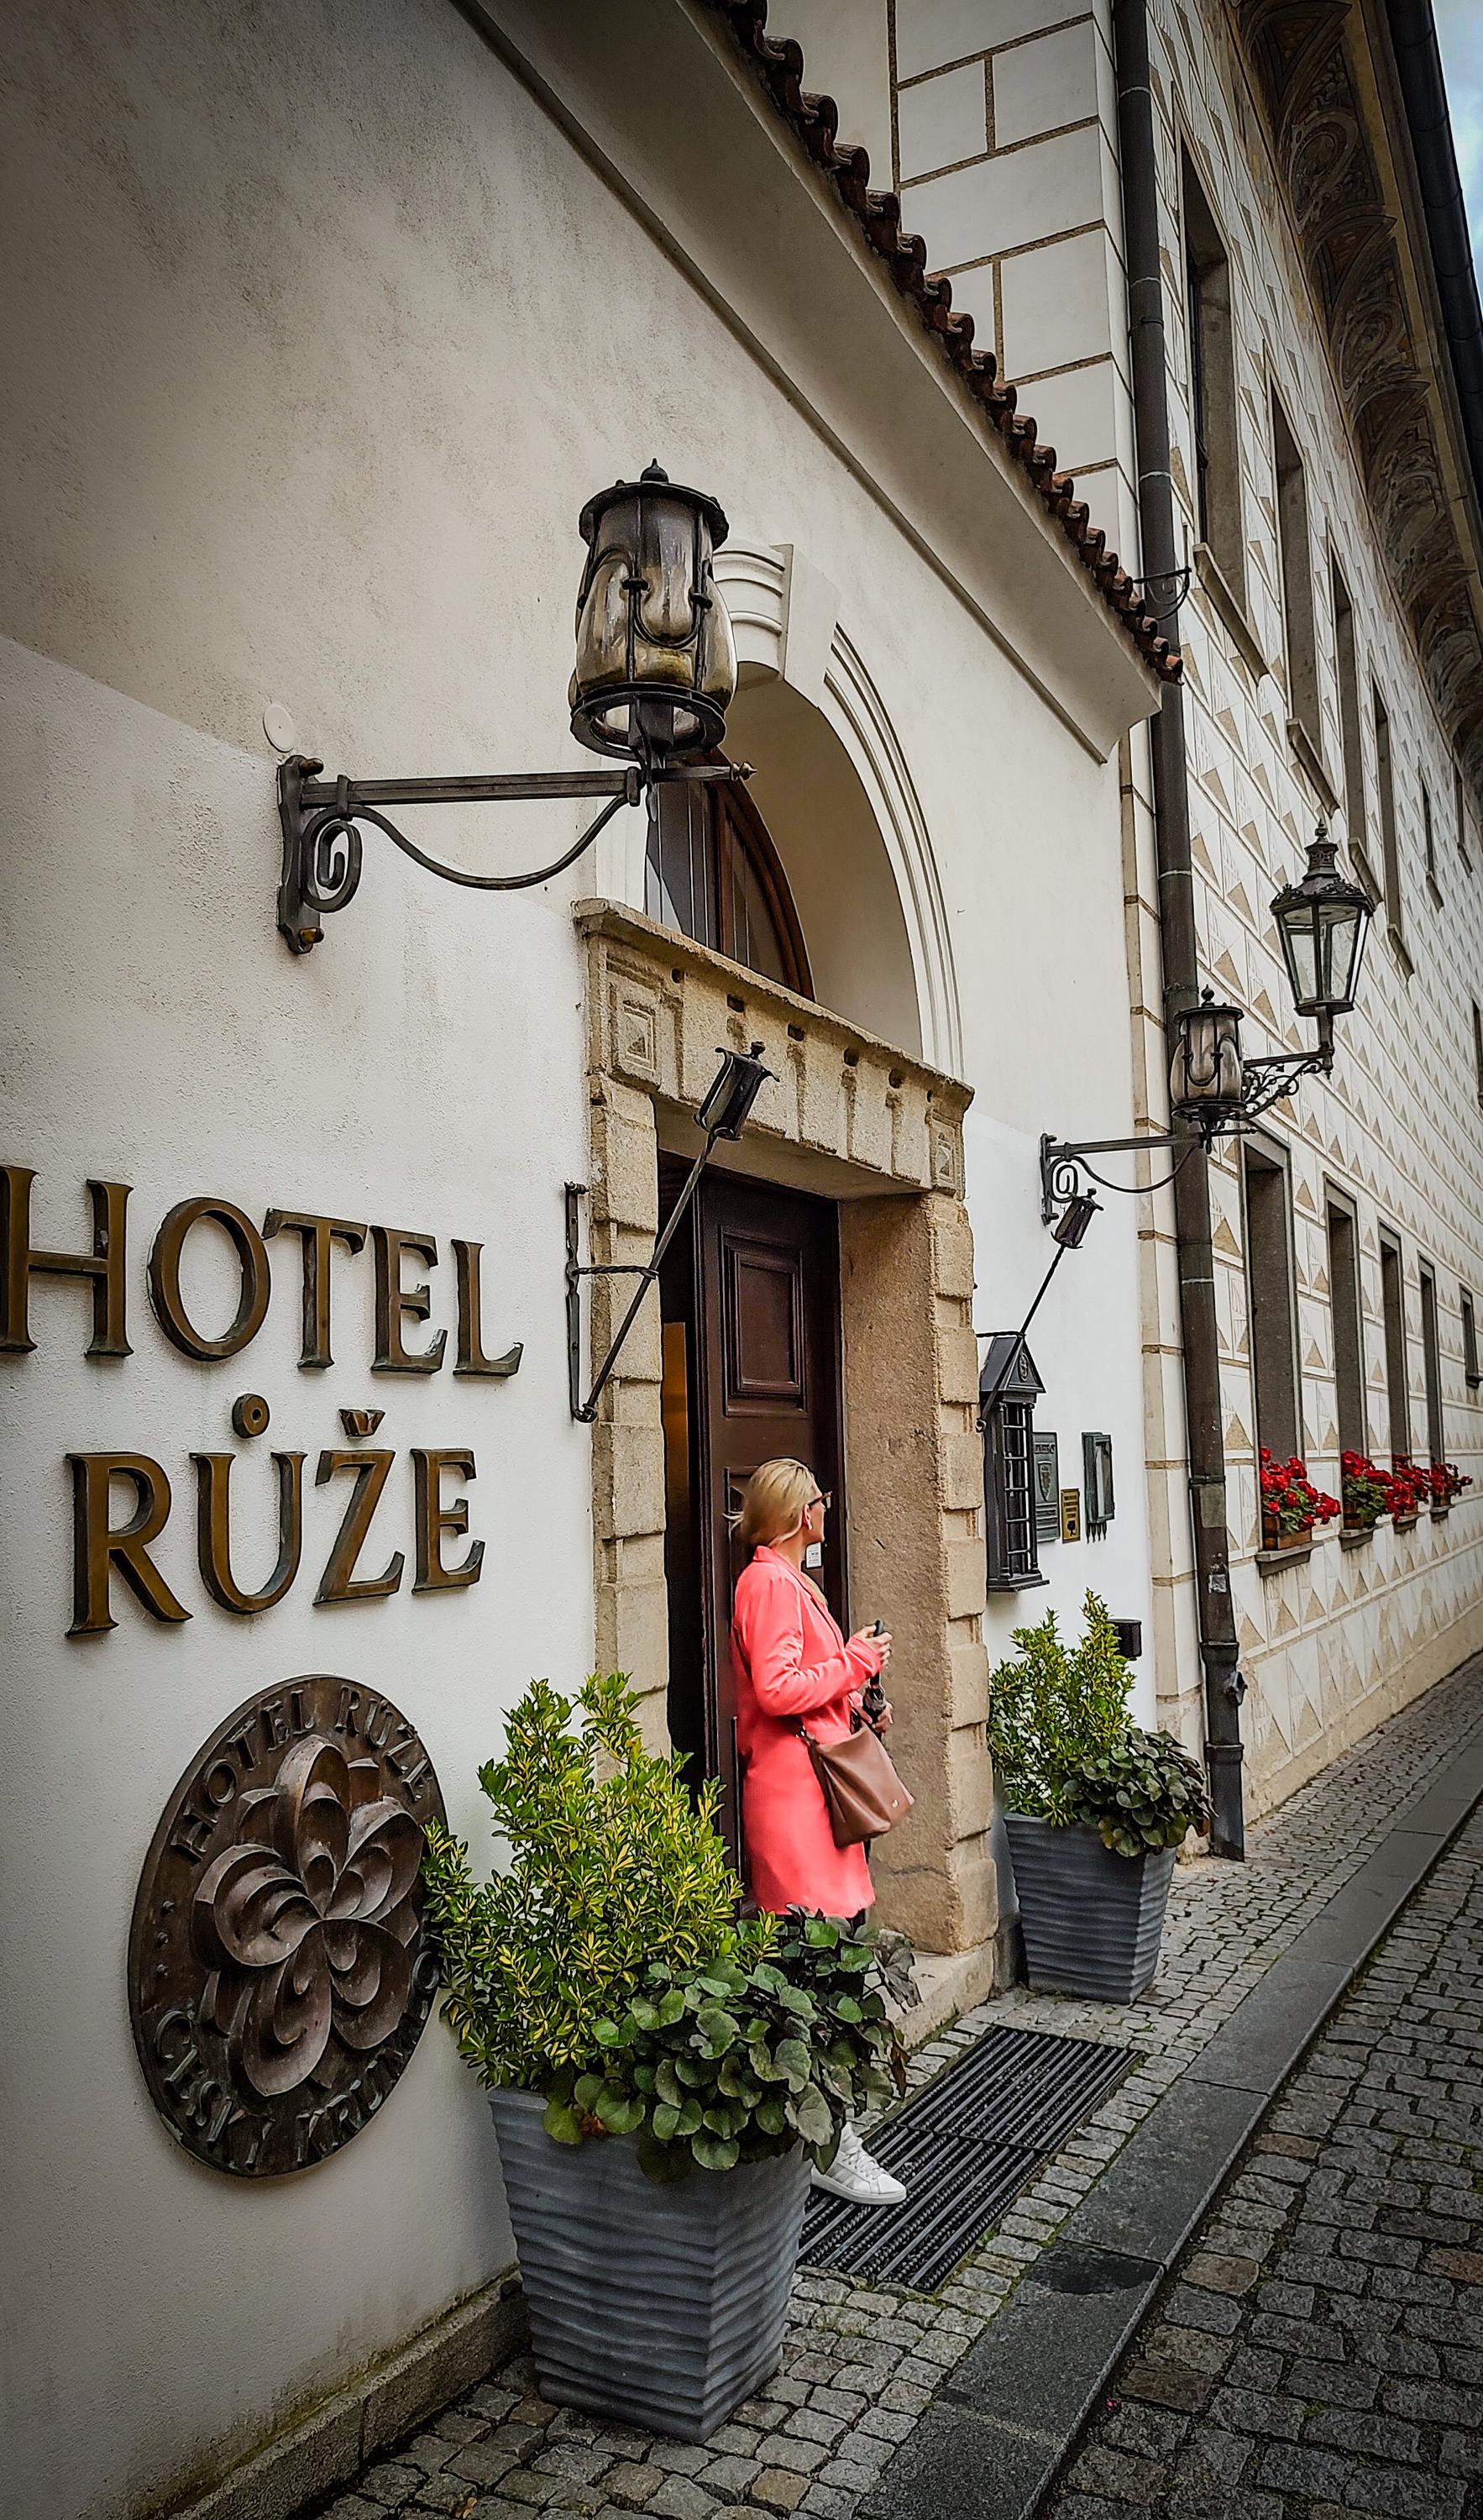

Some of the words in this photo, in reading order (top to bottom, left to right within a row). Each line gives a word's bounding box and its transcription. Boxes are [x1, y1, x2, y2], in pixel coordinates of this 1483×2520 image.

[0, 1164, 524, 1377] HOTEL
[65, 1393, 485, 1637] RŮŽE
[170, 1688, 316, 1863] HOTEL
[335, 1685, 434, 1803] RŮŽE
